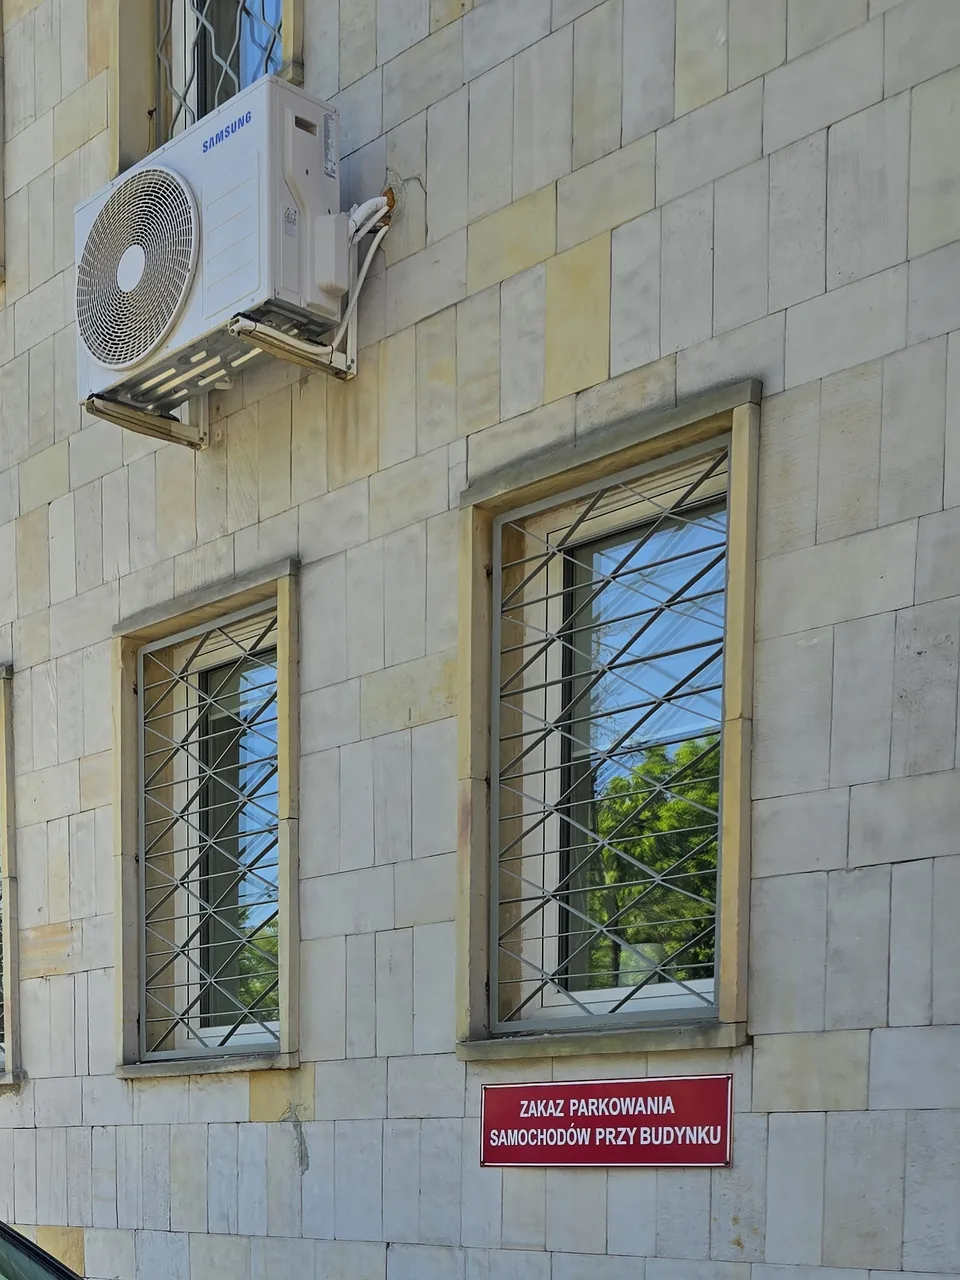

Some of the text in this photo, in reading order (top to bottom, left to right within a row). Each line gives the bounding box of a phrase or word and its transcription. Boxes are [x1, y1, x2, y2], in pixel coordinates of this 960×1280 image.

[202, 110, 252, 153] SAMSUNG
[520, 1096, 675, 1117] ZAKAZ PARKOWANIA
[490, 1122, 721, 1146] SAMOCHODÓW PRZY BUDYNKU
